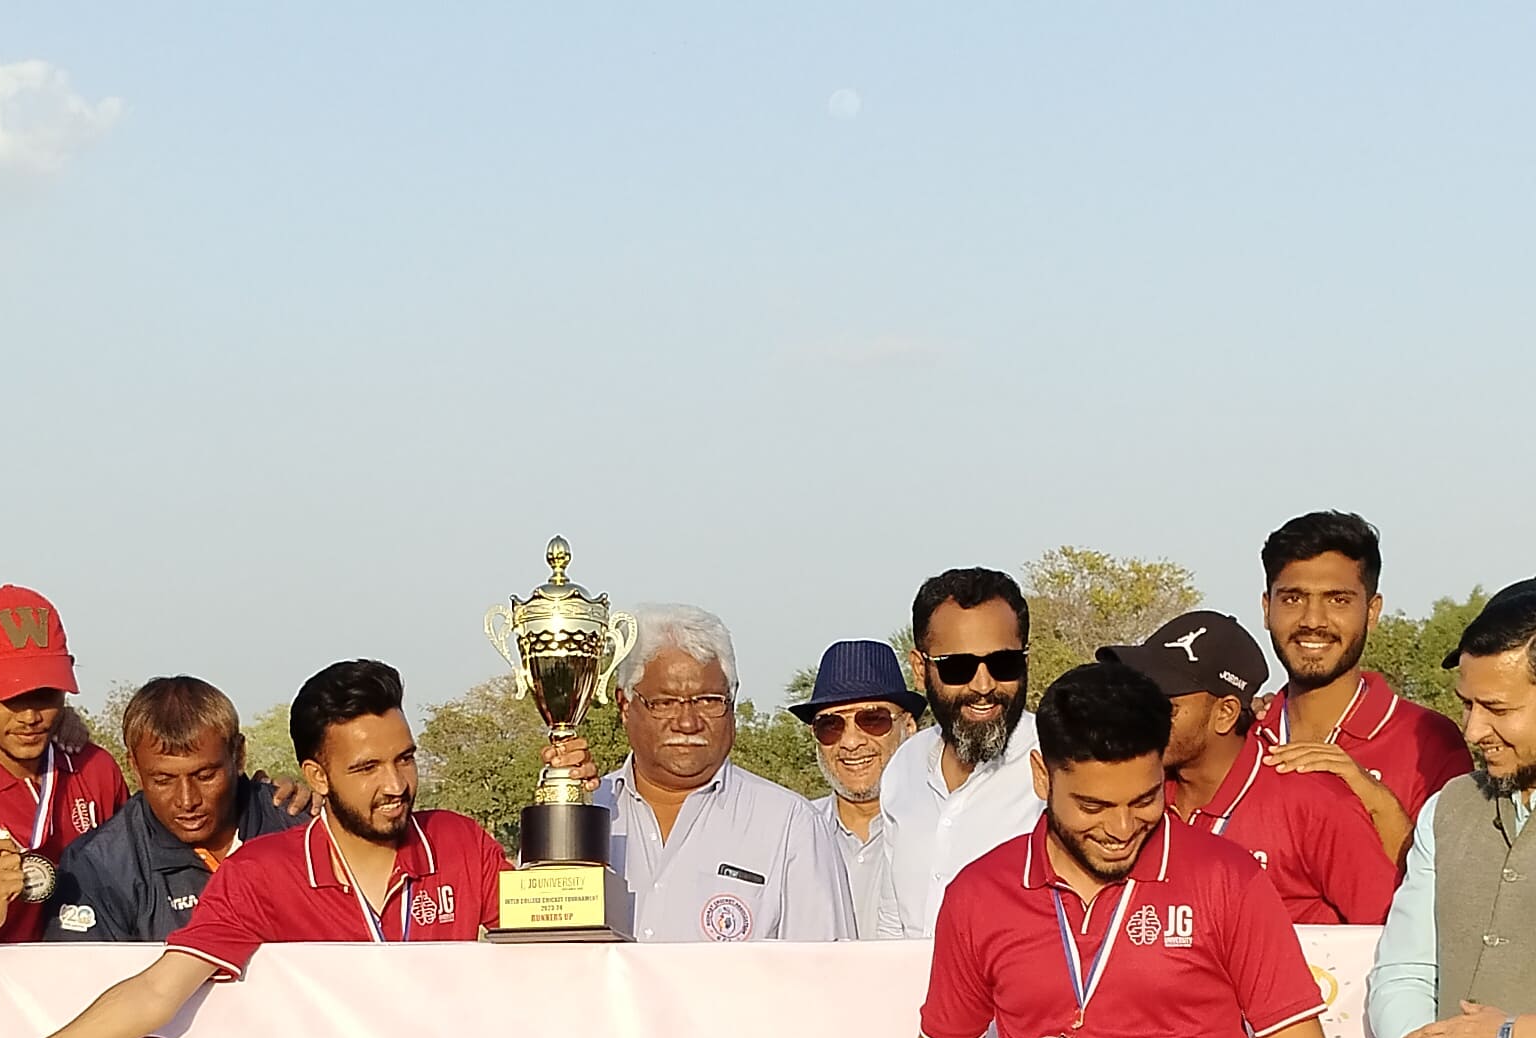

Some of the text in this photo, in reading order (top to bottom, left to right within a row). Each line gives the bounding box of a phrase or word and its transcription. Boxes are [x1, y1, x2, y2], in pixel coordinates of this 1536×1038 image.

[1219, 670, 1248, 691] JORDAN
[437, 885, 454, 914] JG
[1164, 905, 1193, 937] JG
